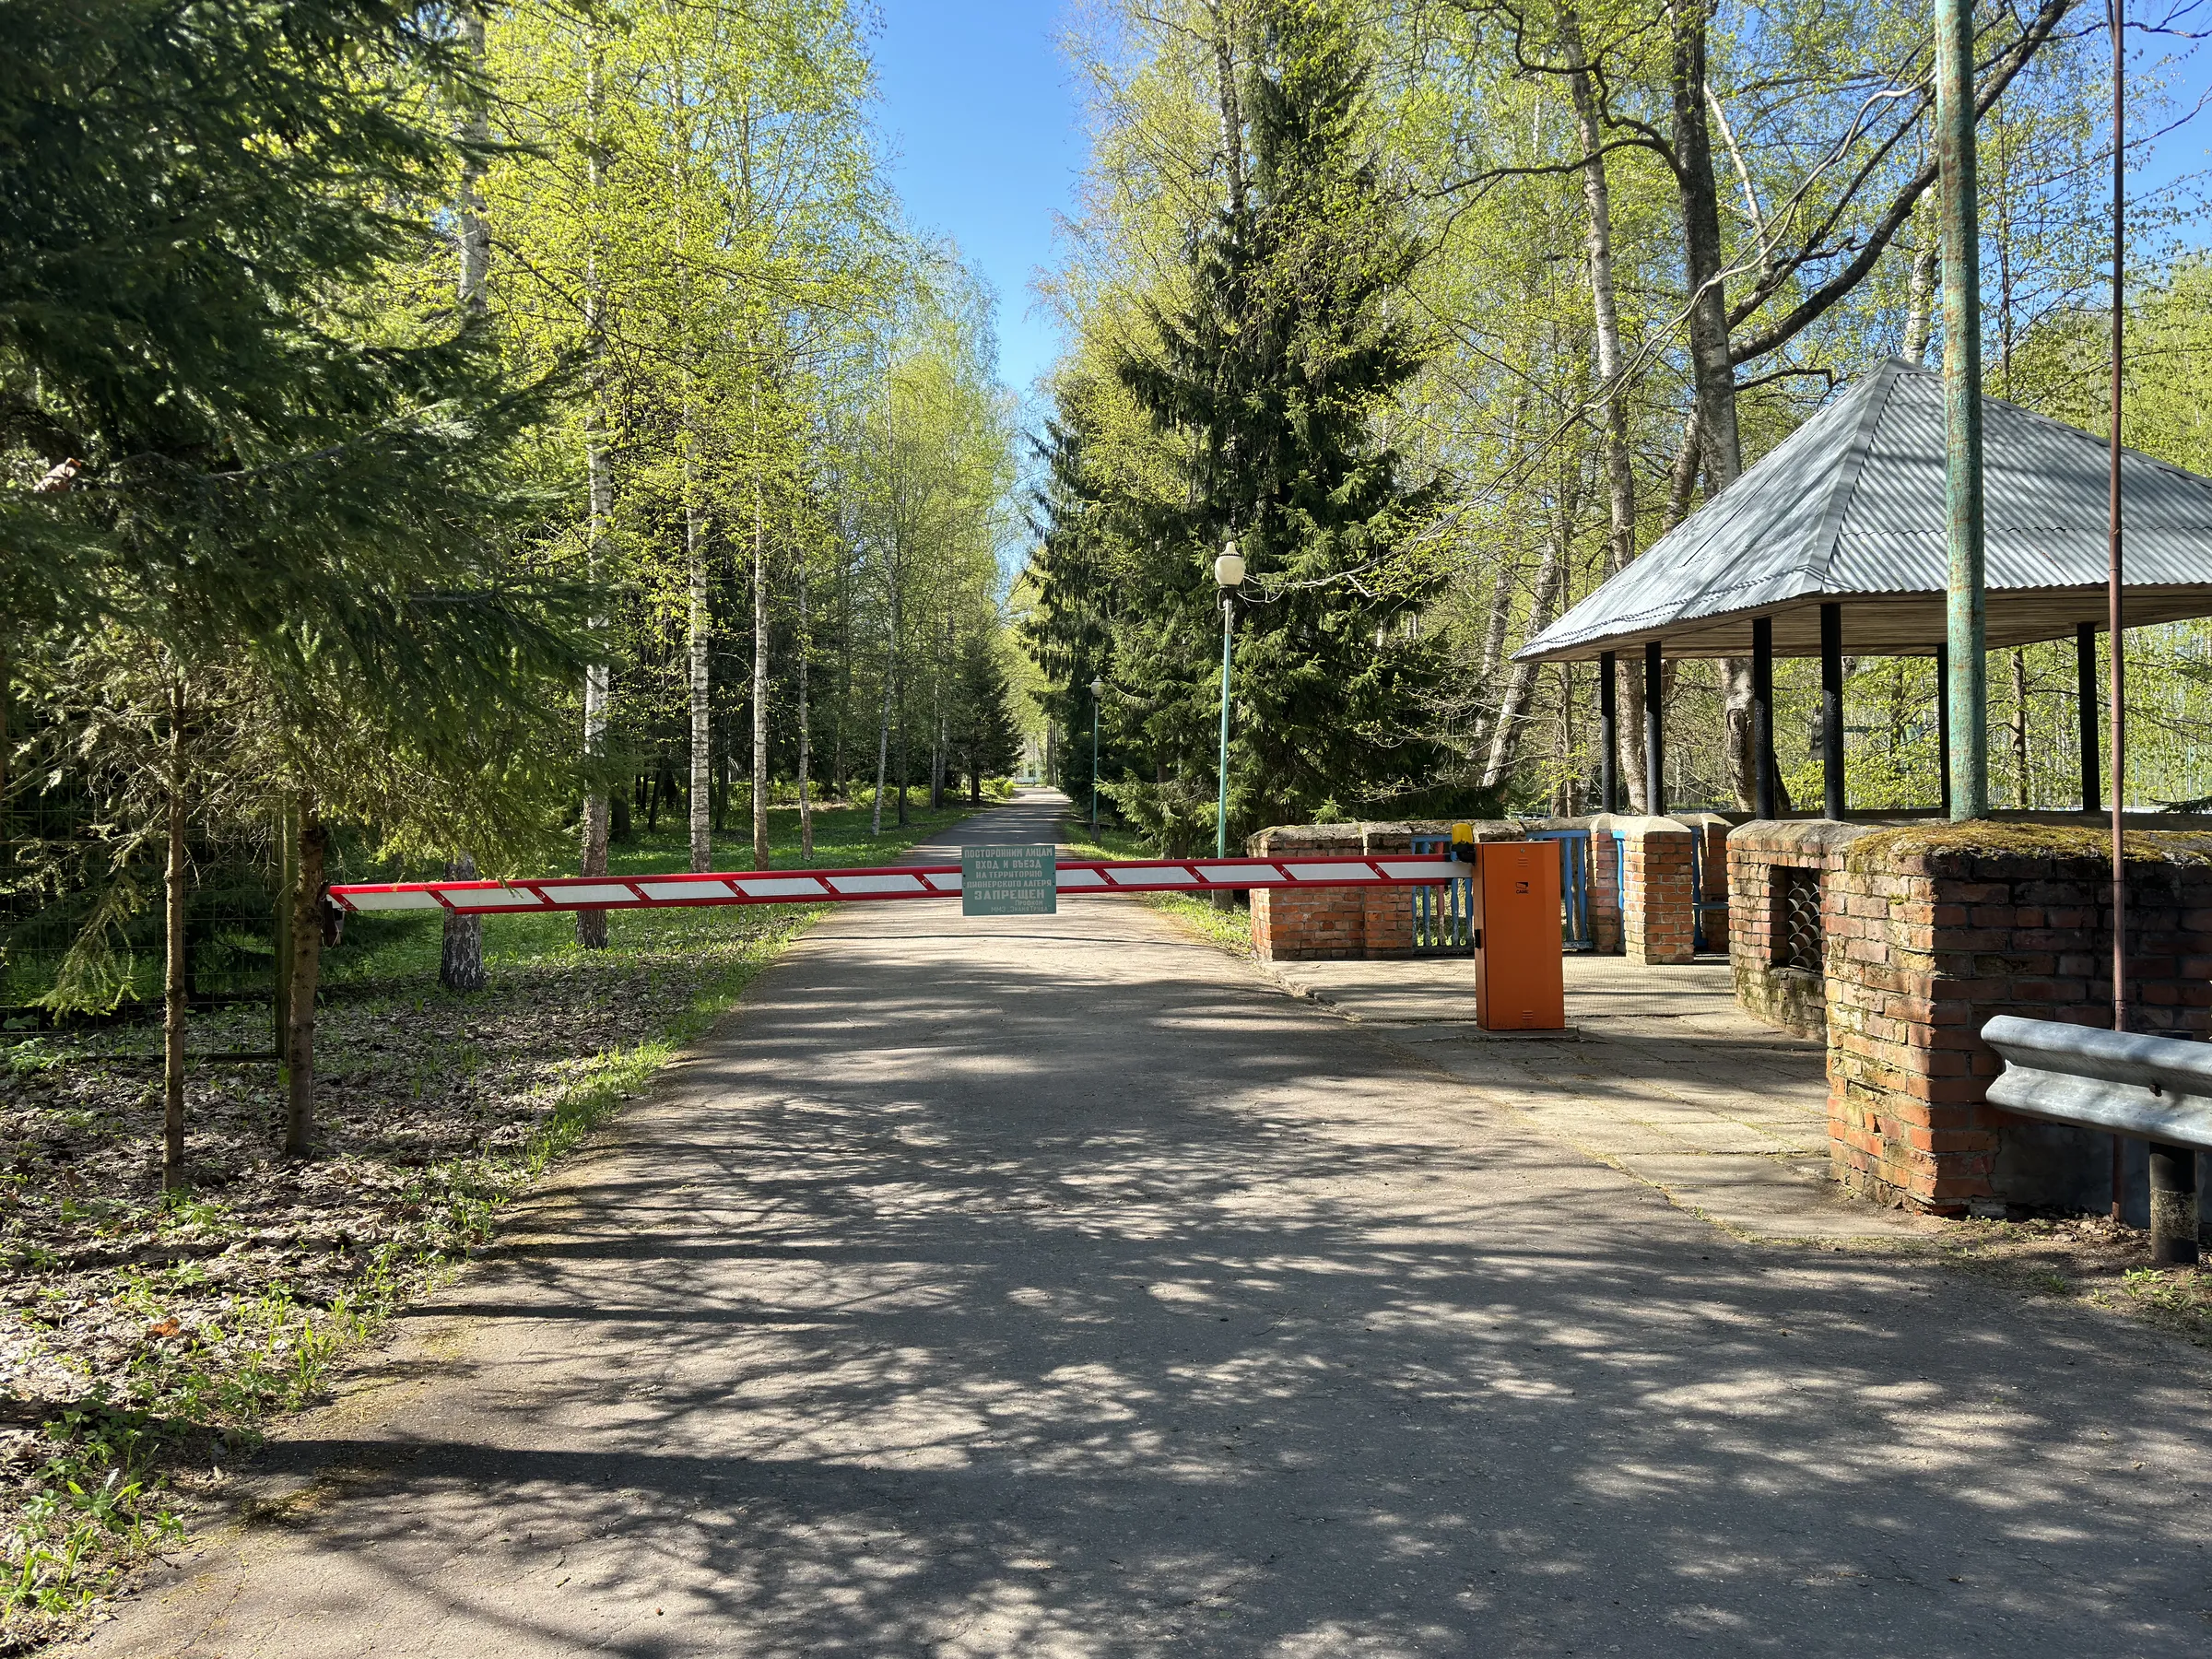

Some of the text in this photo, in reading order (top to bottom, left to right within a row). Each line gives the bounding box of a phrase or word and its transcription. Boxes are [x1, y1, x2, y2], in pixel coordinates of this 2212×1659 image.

[964, 847, 1053, 858] ПОСТОРОННИМ ЛИЦАМ
[975, 859, 1041, 869] ВХОД И ВЪЕЗД
[989, 870, 1042, 878] ТЕРРИТОРИЮ
[974, 889, 1044, 900] ЗАПРЕЩЕН
